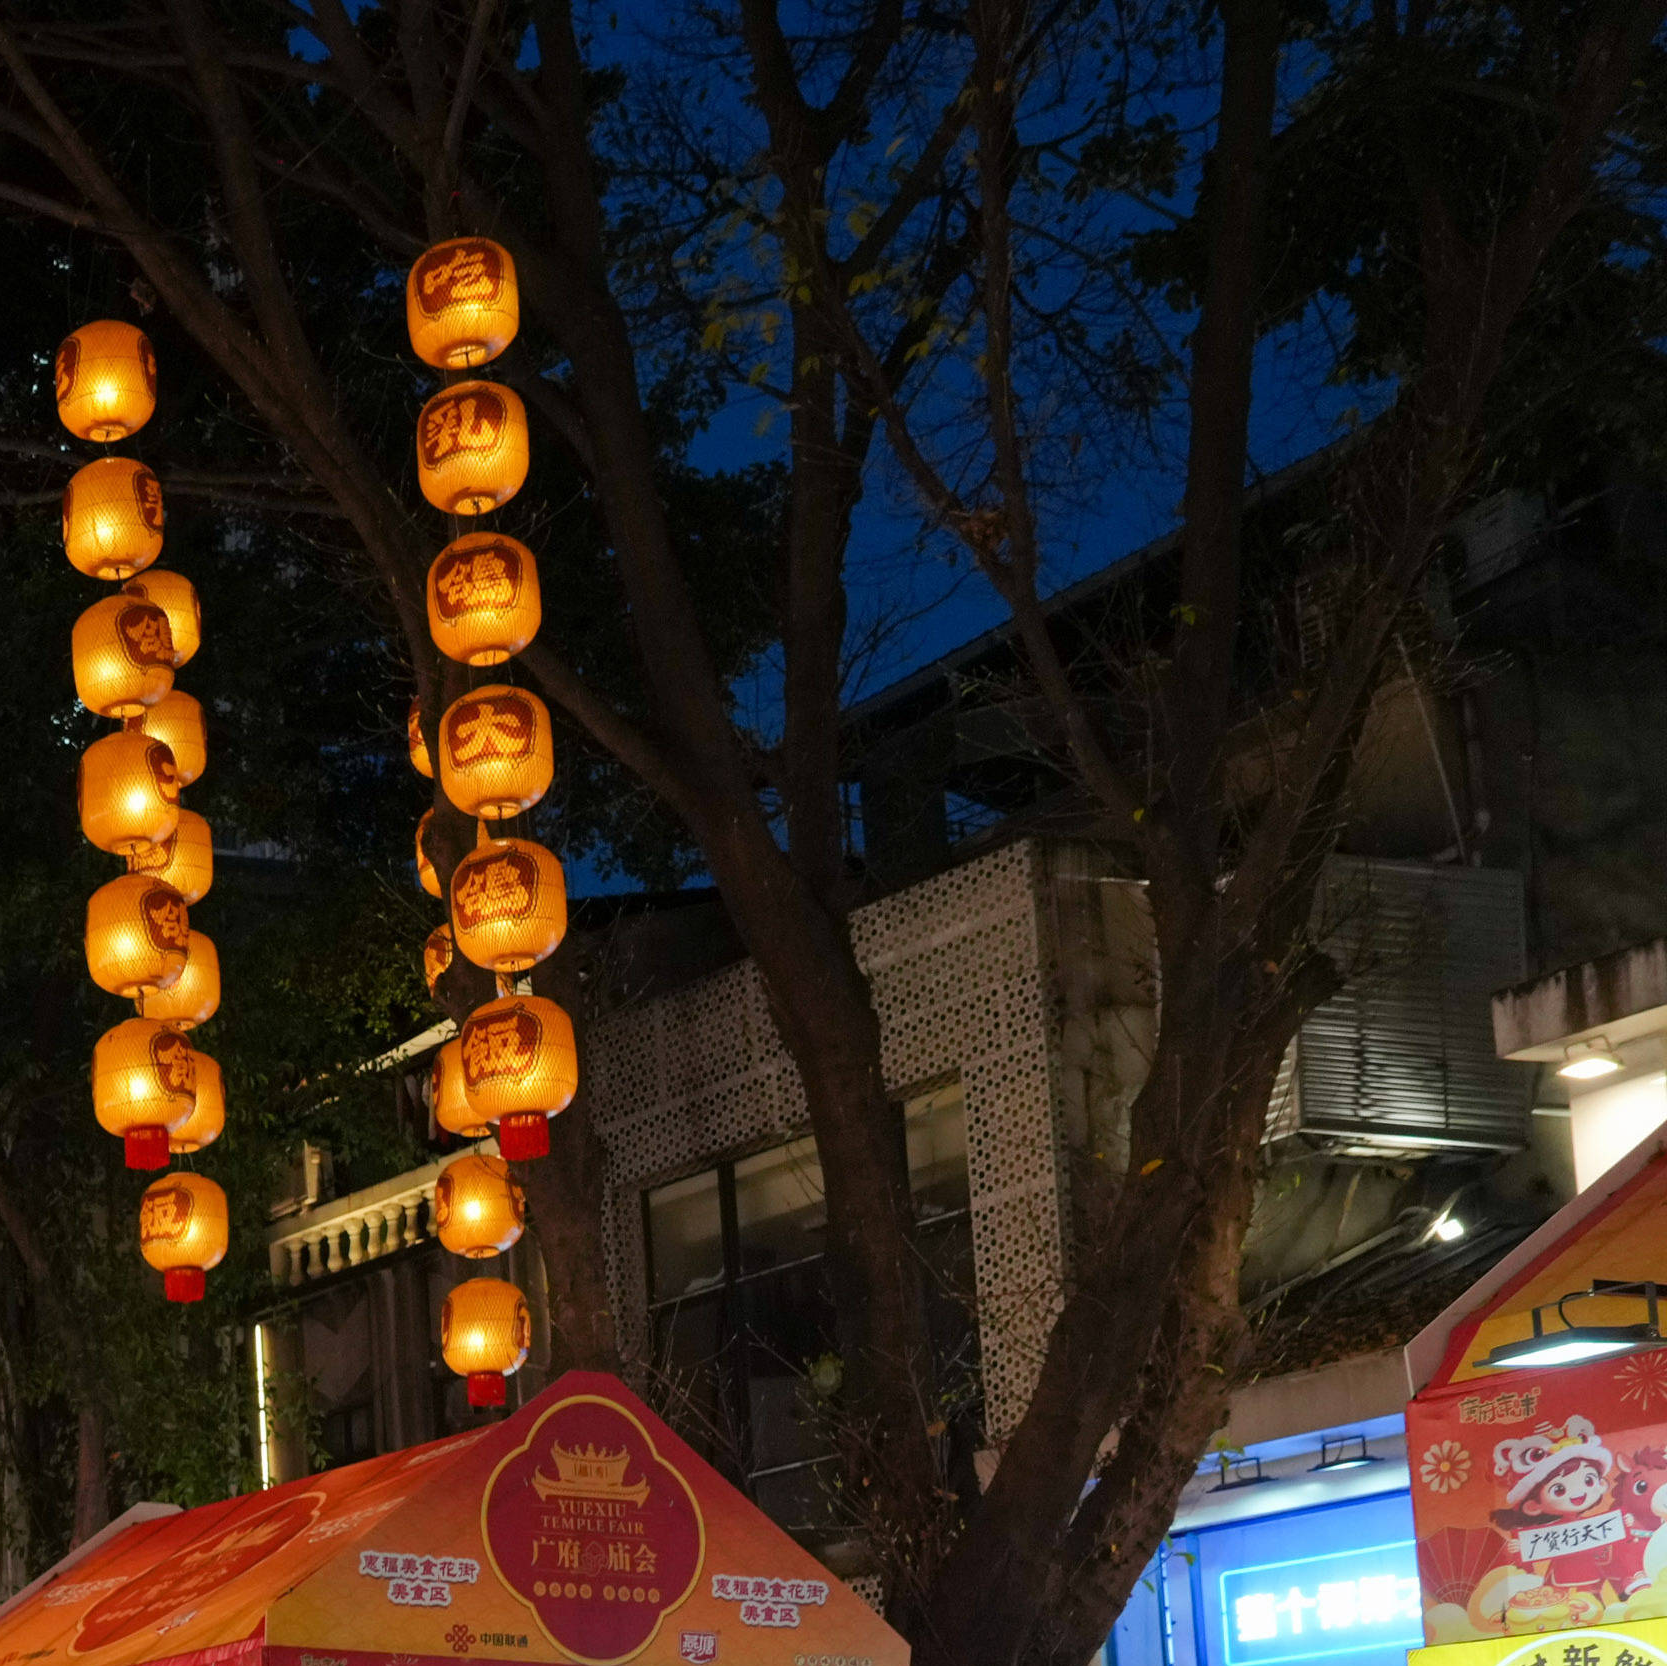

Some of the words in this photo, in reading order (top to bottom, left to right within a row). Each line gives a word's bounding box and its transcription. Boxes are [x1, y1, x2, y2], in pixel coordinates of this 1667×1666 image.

[455, 704, 528, 763] 大
[558, 1499, 626, 1518] YUEXIU
[541, 1515, 605, 1533] TEMPLE
[610, 1521, 644, 1535] FAIR
[1528, 1519, 1615, 1560] 广货行天下
[363, 1554, 477, 1580] 惠福美食花街
[531, 1536, 657, 1574] 广府庙会
[390, 1580, 449, 1603] 美食区
[714, 1578, 826, 1604] 惠福美食花街
[743, 1604, 797, 1624] 美食区
[480, 1632, 529, 1649] 中国联通
